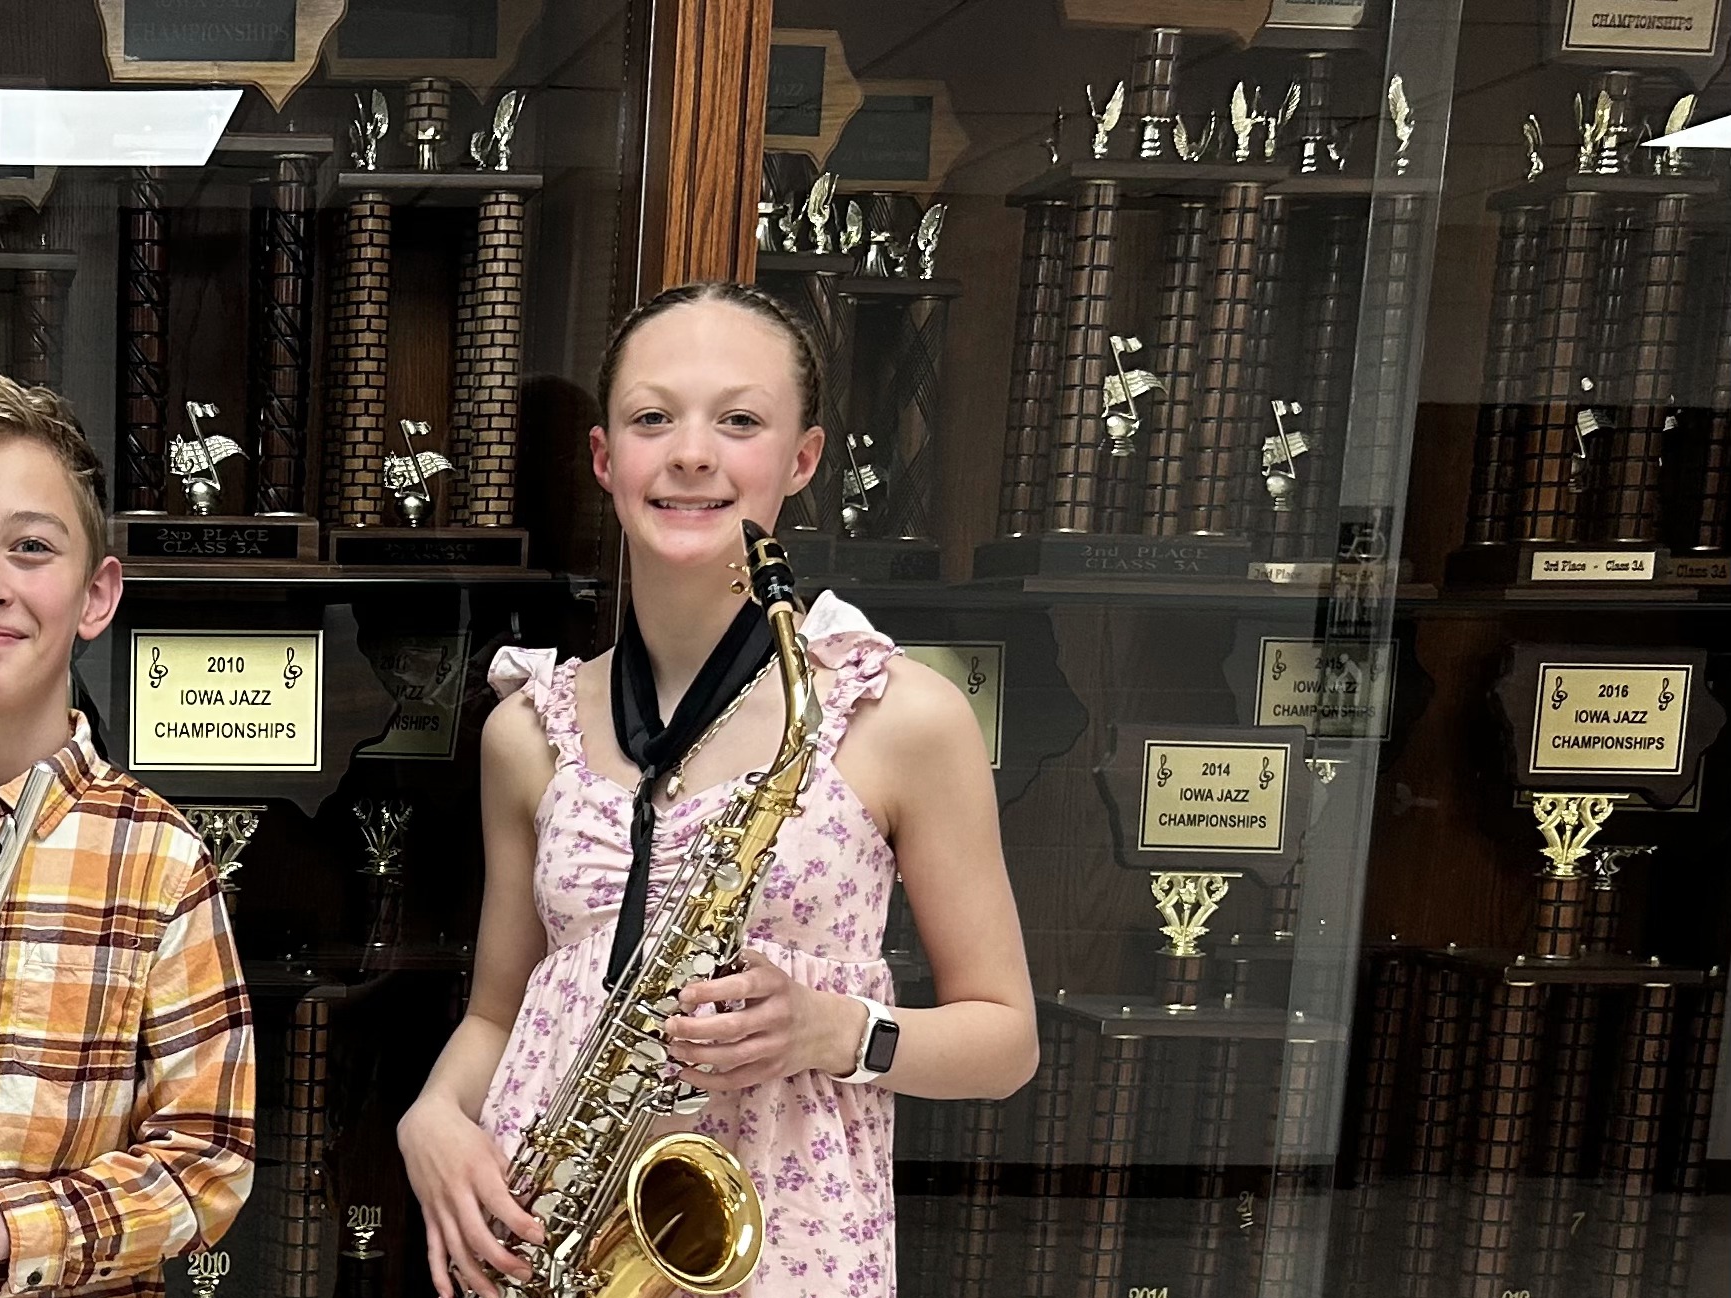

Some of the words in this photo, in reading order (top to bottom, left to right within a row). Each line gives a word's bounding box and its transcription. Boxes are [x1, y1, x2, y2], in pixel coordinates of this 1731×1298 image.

[1592, 13, 1695, 31] CHAMPIONSHIPS
[156, 529, 192, 541] 2ND
[202, 529, 269, 543] PLACE
[162, 541, 227, 554] CLASS
[1137, 546, 1210, 560] PLACE
[1085, 559, 1157, 571] CLASS
[207, 657, 245, 674] 2010
[1293, 680, 1326, 693] IOWA
[1598, 684, 1629, 698] 2016
[180, 689, 225, 706] IOWA
[229, 689, 272, 707] JAZZ
[1574, 710, 1610, 723] IOWA
[1613, 711, 1648, 724] JAZZ
[154, 722, 297, 740] CHAMPIONSHIPS
[1552, 735, 1665, 750] CHAMPIONSHIPS
[1201, 763, 1230, 776] 2014
[1179, 788, 1213, 802] IOWA
[1216, 789, 1250, 802] JAZZ
[1158, 812, 1267, 829] CHAMPIONSHIPS
[347, 1205, 382, 1228] 2011
[187, 1251, 230, 1276] 2010
